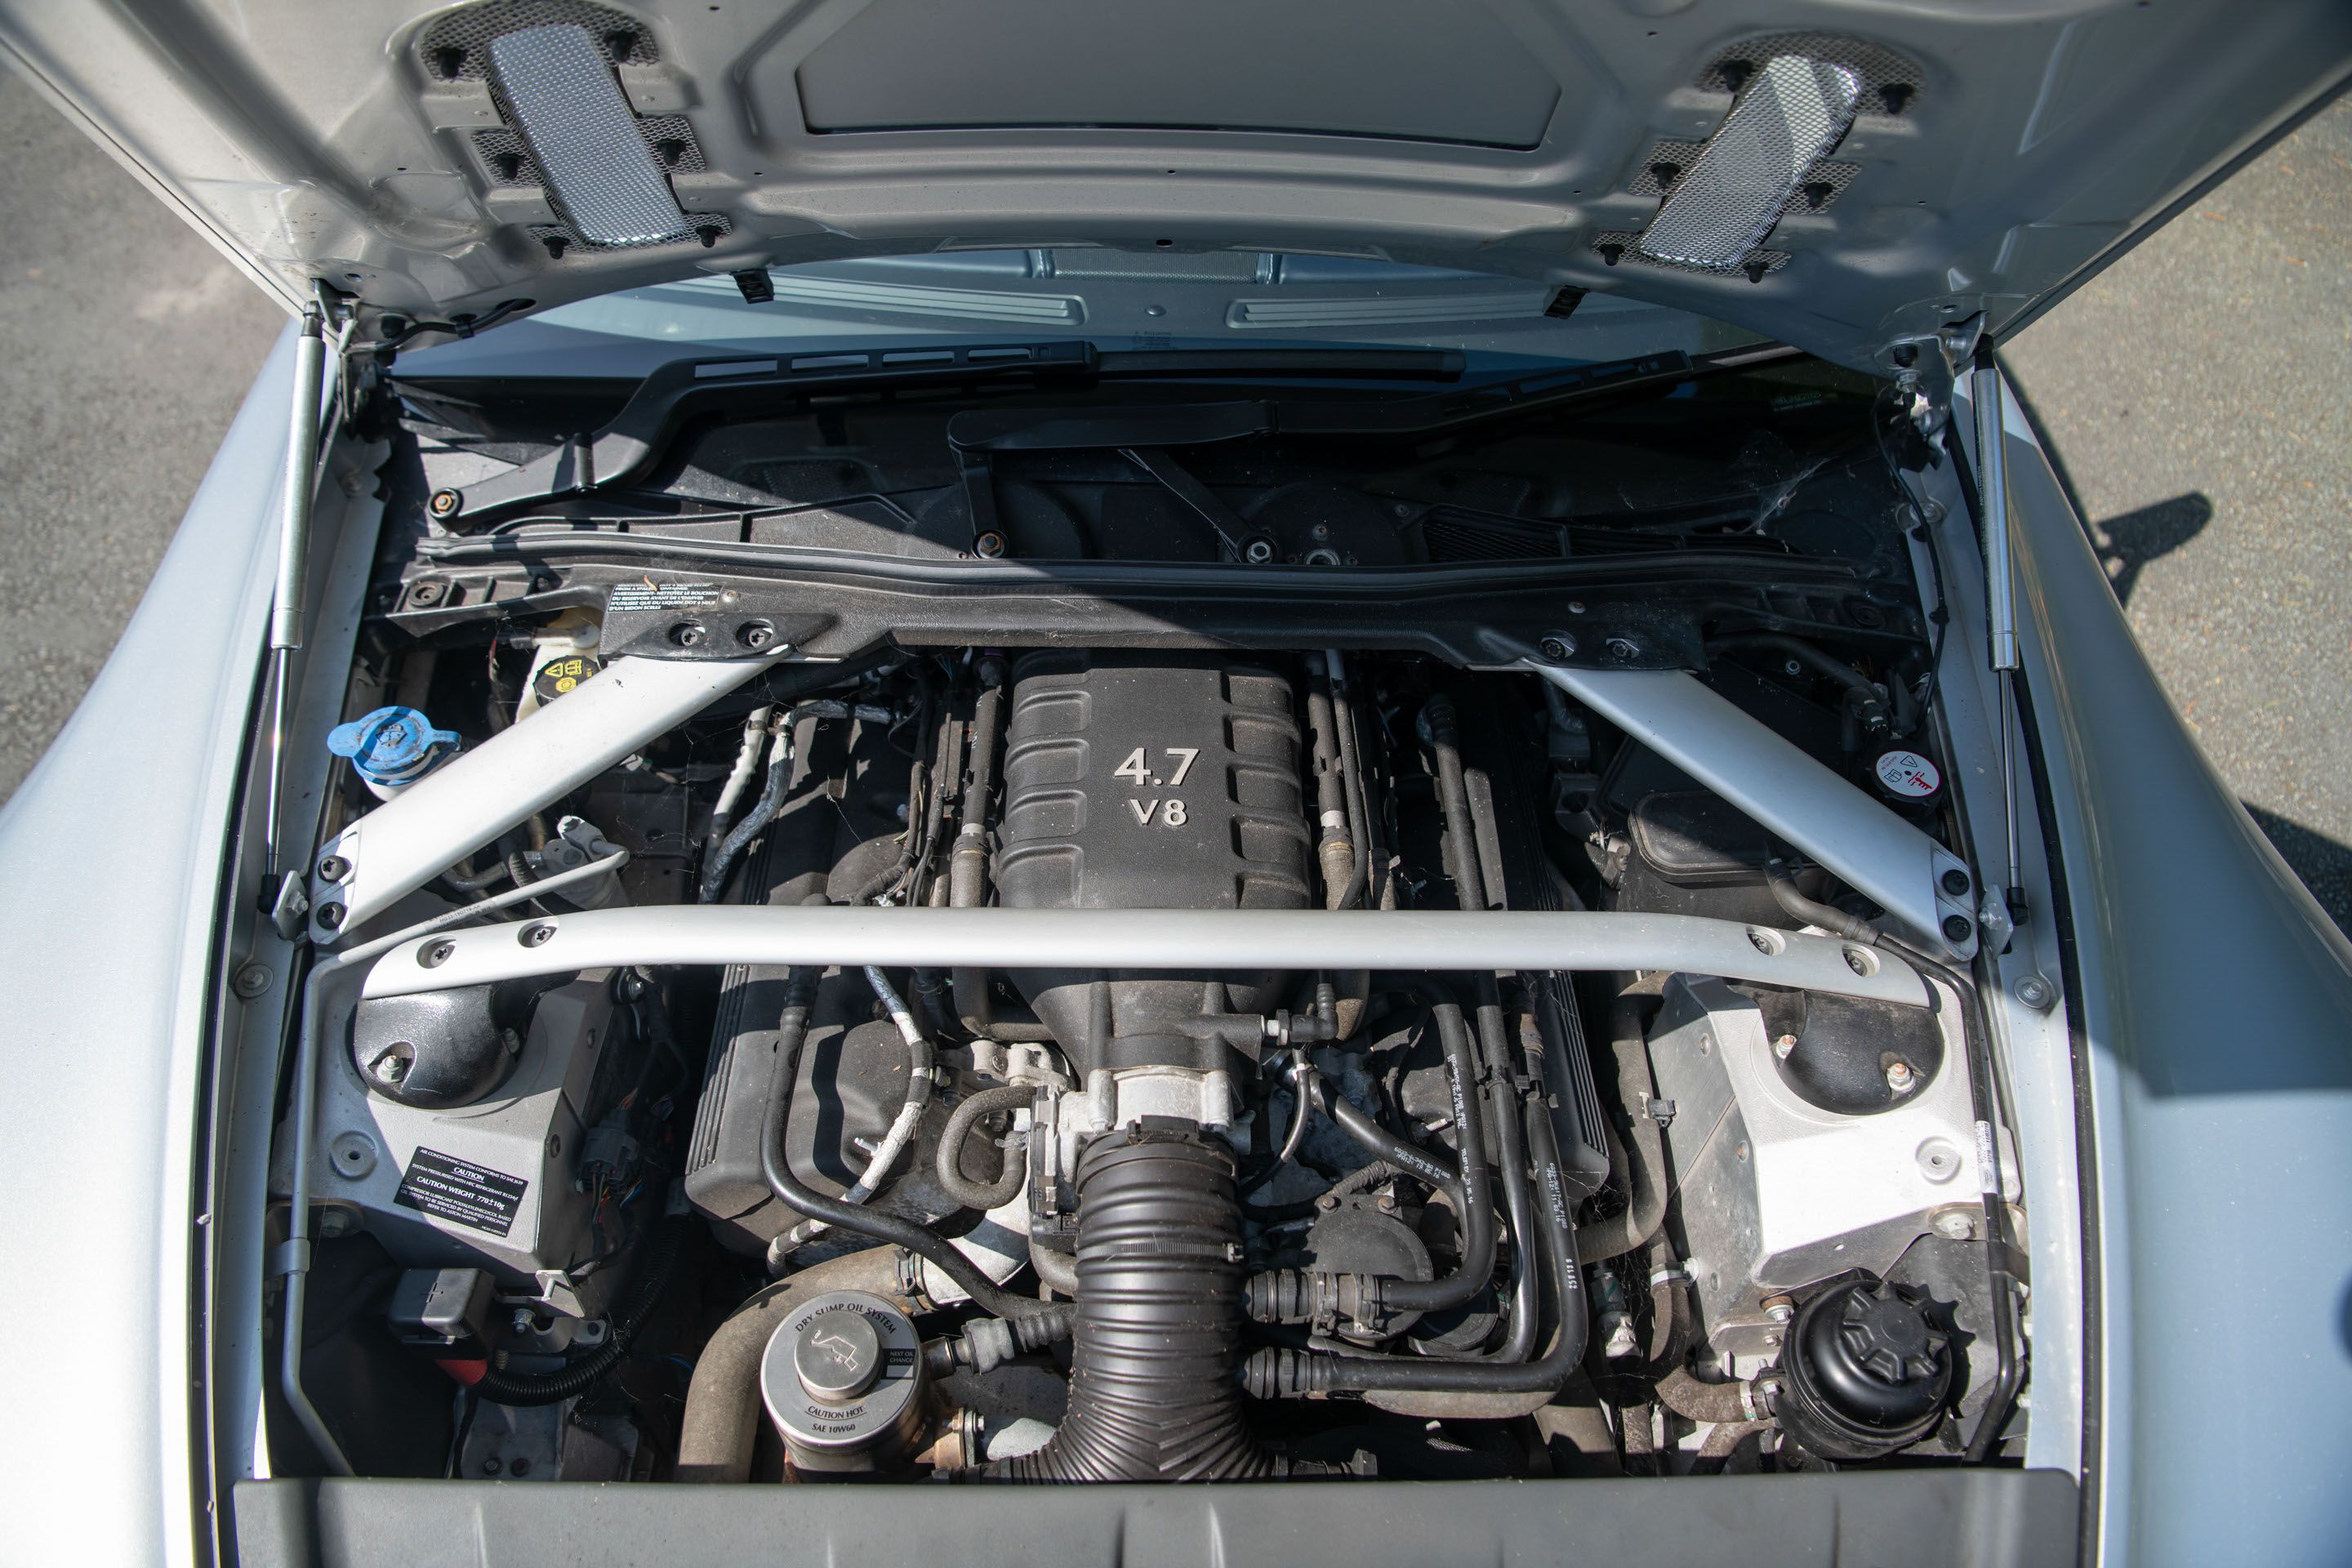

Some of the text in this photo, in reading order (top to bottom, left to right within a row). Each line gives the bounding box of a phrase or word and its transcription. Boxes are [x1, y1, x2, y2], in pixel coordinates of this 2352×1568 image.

[1114, 747, 1200, 786] 4.7
[1129, 799, 1187, 827] V8
[428, 1152, 460, 1165] CONDITIONING
[475, 1168, 499, 1178] CONFORMS
[454, 1167, 484, 1181] CAUTION
[402, 1184, 430, 1196] COMPRESSOR
[430, 1193, 453, 1203] LUBRICANT
[416, 1176, 505, 1210] CAUTION WEIGHT 770±10g
[428, 1169, 454, 1180] PRESSURISED
[475, 1184, 501, 1195] REFRIGERANT
[408, 1192, 424, 1200] SYSTEM
[437, 1200, 456, 1209] SERVICED
[462, 1209, 484, 1218] QUALIFIED
[484, 1216, 508, 1226] PERSONNEL
[795, 1314, 813, 1332] DRY
[847, 1303, 863, 1313] OIL
[865, 1307, 897, 1334] SYSTEM
[808, 1405, 864, 1419] CAUTION HOT
[812, 1423, 856, 1433] SAE 10W60
